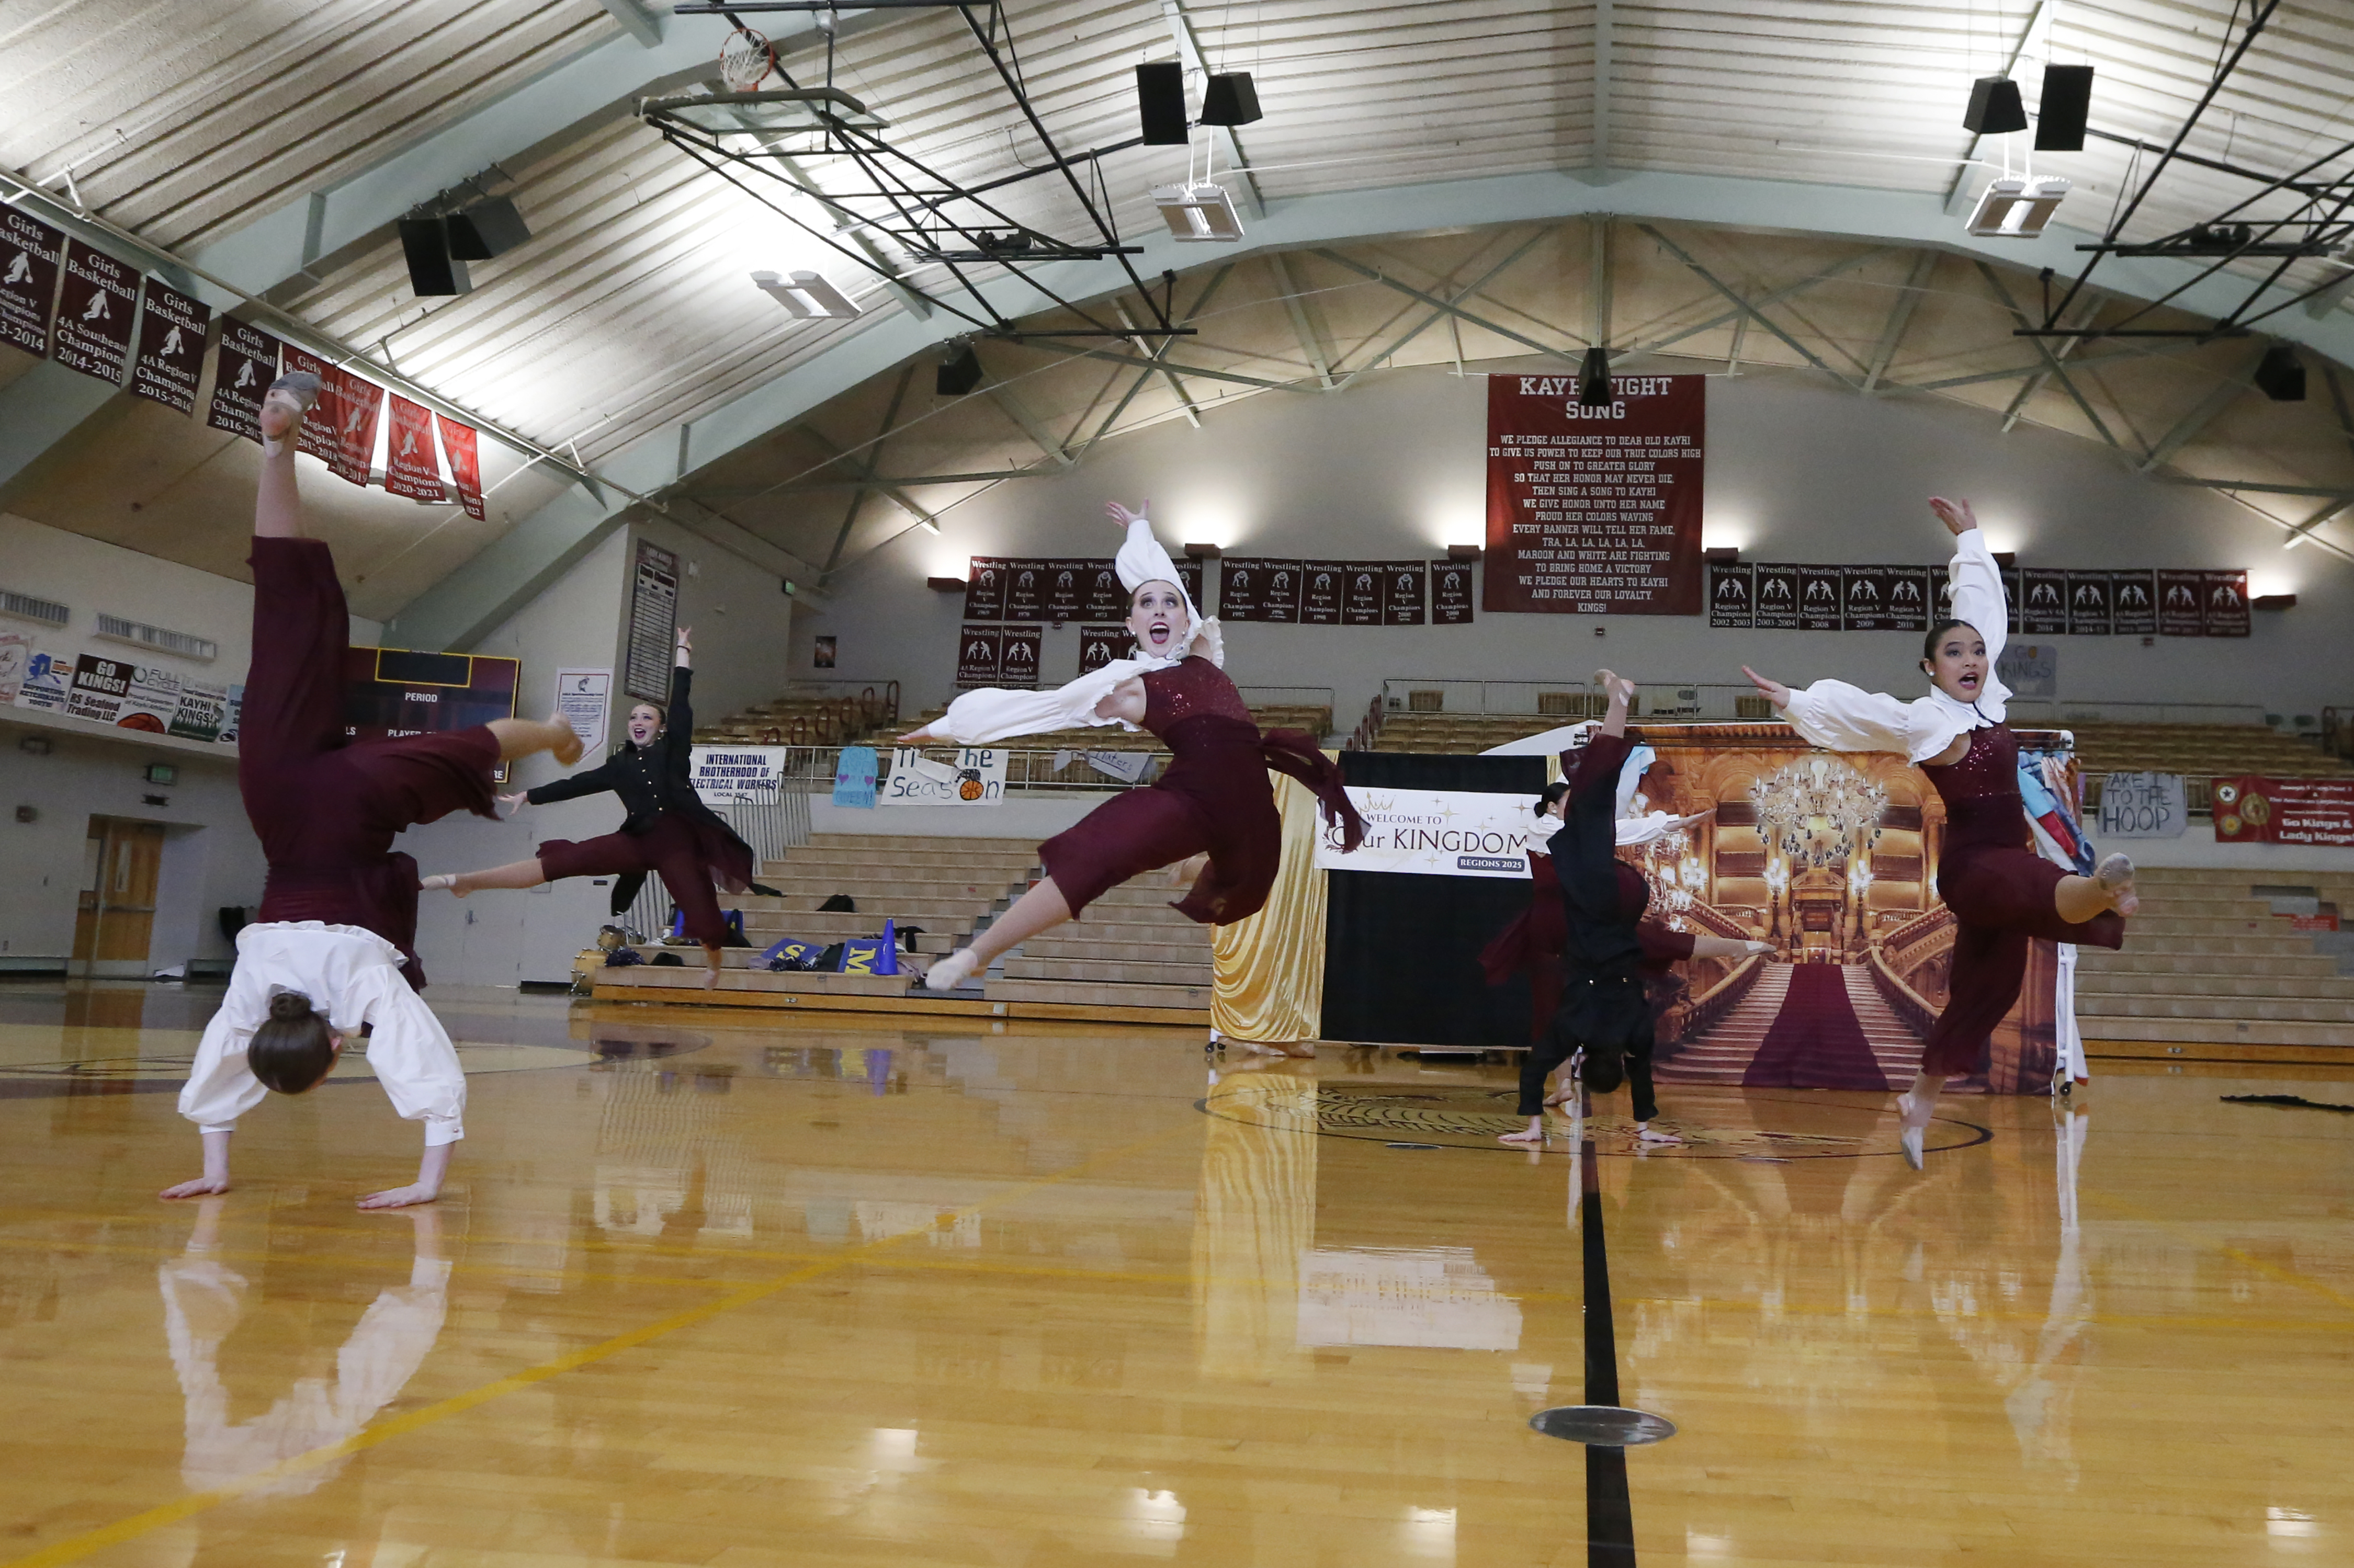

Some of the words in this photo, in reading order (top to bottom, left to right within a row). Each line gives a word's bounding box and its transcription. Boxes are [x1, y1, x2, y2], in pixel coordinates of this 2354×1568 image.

[8, 214, 43, 241] Girls
[0, 228, 59, 266] asketball
[88, 254, 120, 278] Girls
[67, 258, 135, 301] Basketball
[164, 293, 193, 315] Girls
[145, 298, 206, 335] Basketball
[58, 316, 74, 330] 4A
[77, 324, 127, 353] Southeast
[237, 328, 264, 348] Girls
[57, 329, 125, 366] Champions
[221, 334, 276, 368] Basketball
[58, 347, 122, 382] 2014-2015
[141, 355, 155, 367] 4A
[157, 358, 190, 381] Region
[298, 356, 322, 374] Girls
[136, 367, 195, 400] Champions
[1520, 377, 1579, 395] KAYH
[1611, 378, 1672, 395] IGHT
[139, 383, 191, 412] 2015-2016
[217, 388, 230, 399] 4A
[231, 390, 261, 411] Region
[1566, 401, 1625, 419] SONG
[1501, 435, 1513, 444] WE
[1516, 435, 1547, 444] PLEDGE
[1551, 436, 1602, 445] ALLEGIANCE
[1605, 436, 1615, 445] TO
[1619, 436, 1642, 445] DEAR
[1645, 436, 1660, 445] OLD
[1664, 436, 1690, 445] KAYHI
[1489, 448, 1499, 456] TO
[1502, 448, 1521, 457] GIVE
[1524, 448, 1534, 457] US
[1537, 449, 1565, 457] POWER
[1568, 449, 1578, 457] TO
[1582, 449, 1603, 457] KEEP
[1606, 449, 1621, 457] OUR
[1624, 449, 1646, 458] TRUE
[1649, 449, 1678, 458] COLORS
[393, 456, 422, 474] Region
[1534, 461, 1556, 470] PUSH
[1559, 461, 1570, 470] ON
[1574, 461, 1584, 470] TO
[1587, 462, 1625, 470] GREATER
[1629, 462, 1655, 471] GLORY
[389, 466, 442, 486] Champions
[393, 480, 439, 496] 2020-2021
[1523, 499, 1536, 508] WE
[1540, 499, 1559, 508] GIVE
[1563, 499, 1590, 508] HONOR
[1594, 500, 1616, 508] UNTO
[1620, 500, 1636, 508] HER
[1640, 500, 1665, 509] NAME
[1535, 512, 1562, 520] PROUD
[1566, 512, 1582, 521] HER
[1586, 513, 1616, 521] COLORS
[1620, 513, 1653, 521] WAVING
[1518, 550, 1554, 559] MAROON
[1557, 551, 1575, 559] AND
[1579, 551, 1606, 560] WHITE
[1609, 551, 1627, 560] ARE
[1631, 551, 1670, 561] FIGHTING
[971, 560, 1006, 570] Wrestling
[1010, 562, 1045, 571] Wrestling
[1049, 562, 1083, 571] Wrestling
[1224, 561, 1259, 570] Wrestling
[1346, 565, 1383, 573] Wrestling
[1758, 565, 1796, 574] Wrestling
[1801, 567, 1840, 576] Wrestling
[1886, 568, 1927, 576] Wrestling
[1519, 576, 1532, 585] WE
[1535, 576, 1567, 585] PLEDGE
[1570, 576, 1587, 585] OUR
[1590, 577, 1623, 586] HEARTS
[1627, 577, 1637, 586] TO
[1640, 577, 1668, 587] KAYHI
[1532, 589, 1549, 598] AND
[1553, 589, 1591, 599] FOREVER
[1595, 590, 1611, 599] OUR
[1578, 603, 1606, 612] KINGS!
[963, 628, 1000, 637] Wrestling
[1004, 629, 1040, 639] Wrestling
[97, 661, 116, 676] GO
[2000, 661, 2051, 679] KINGS
[77, 672, 126, 693] KINGS!
[150, 669, 180, 684] FULL
[147, 678, 179, 691] CYCLE
[85, 696, 120, 712] Seafood
[180, 696, 211, 711] KAYHI
[405, 692, 437, 702] PERIOD
[66, 703, 101, 720] Trading
[706, 754, 766, 765] INTERNATIONAL
[965, 748, 994, 767] he
[699, 766, 757, 777] BROTHERHOOD
[760, 767, 770, 777] OF
[737, 779, 777, 790] WORKERS
[2107, 789, 2133, 804] TO
[2135, 789, 2171, 805] THE
[1366, 813, 1422, 824] WELCOME
[1426, 816, 1442, 825] TO
[2103, 806, 2169, 832] HOOP
[2302, 819, 2341, 830] Kings
[1394, 828, 1527, 855] KINGDOM
[2280, 830, 2312, 843] Lady
[1461, 859, 1500, 868] REGIONS
